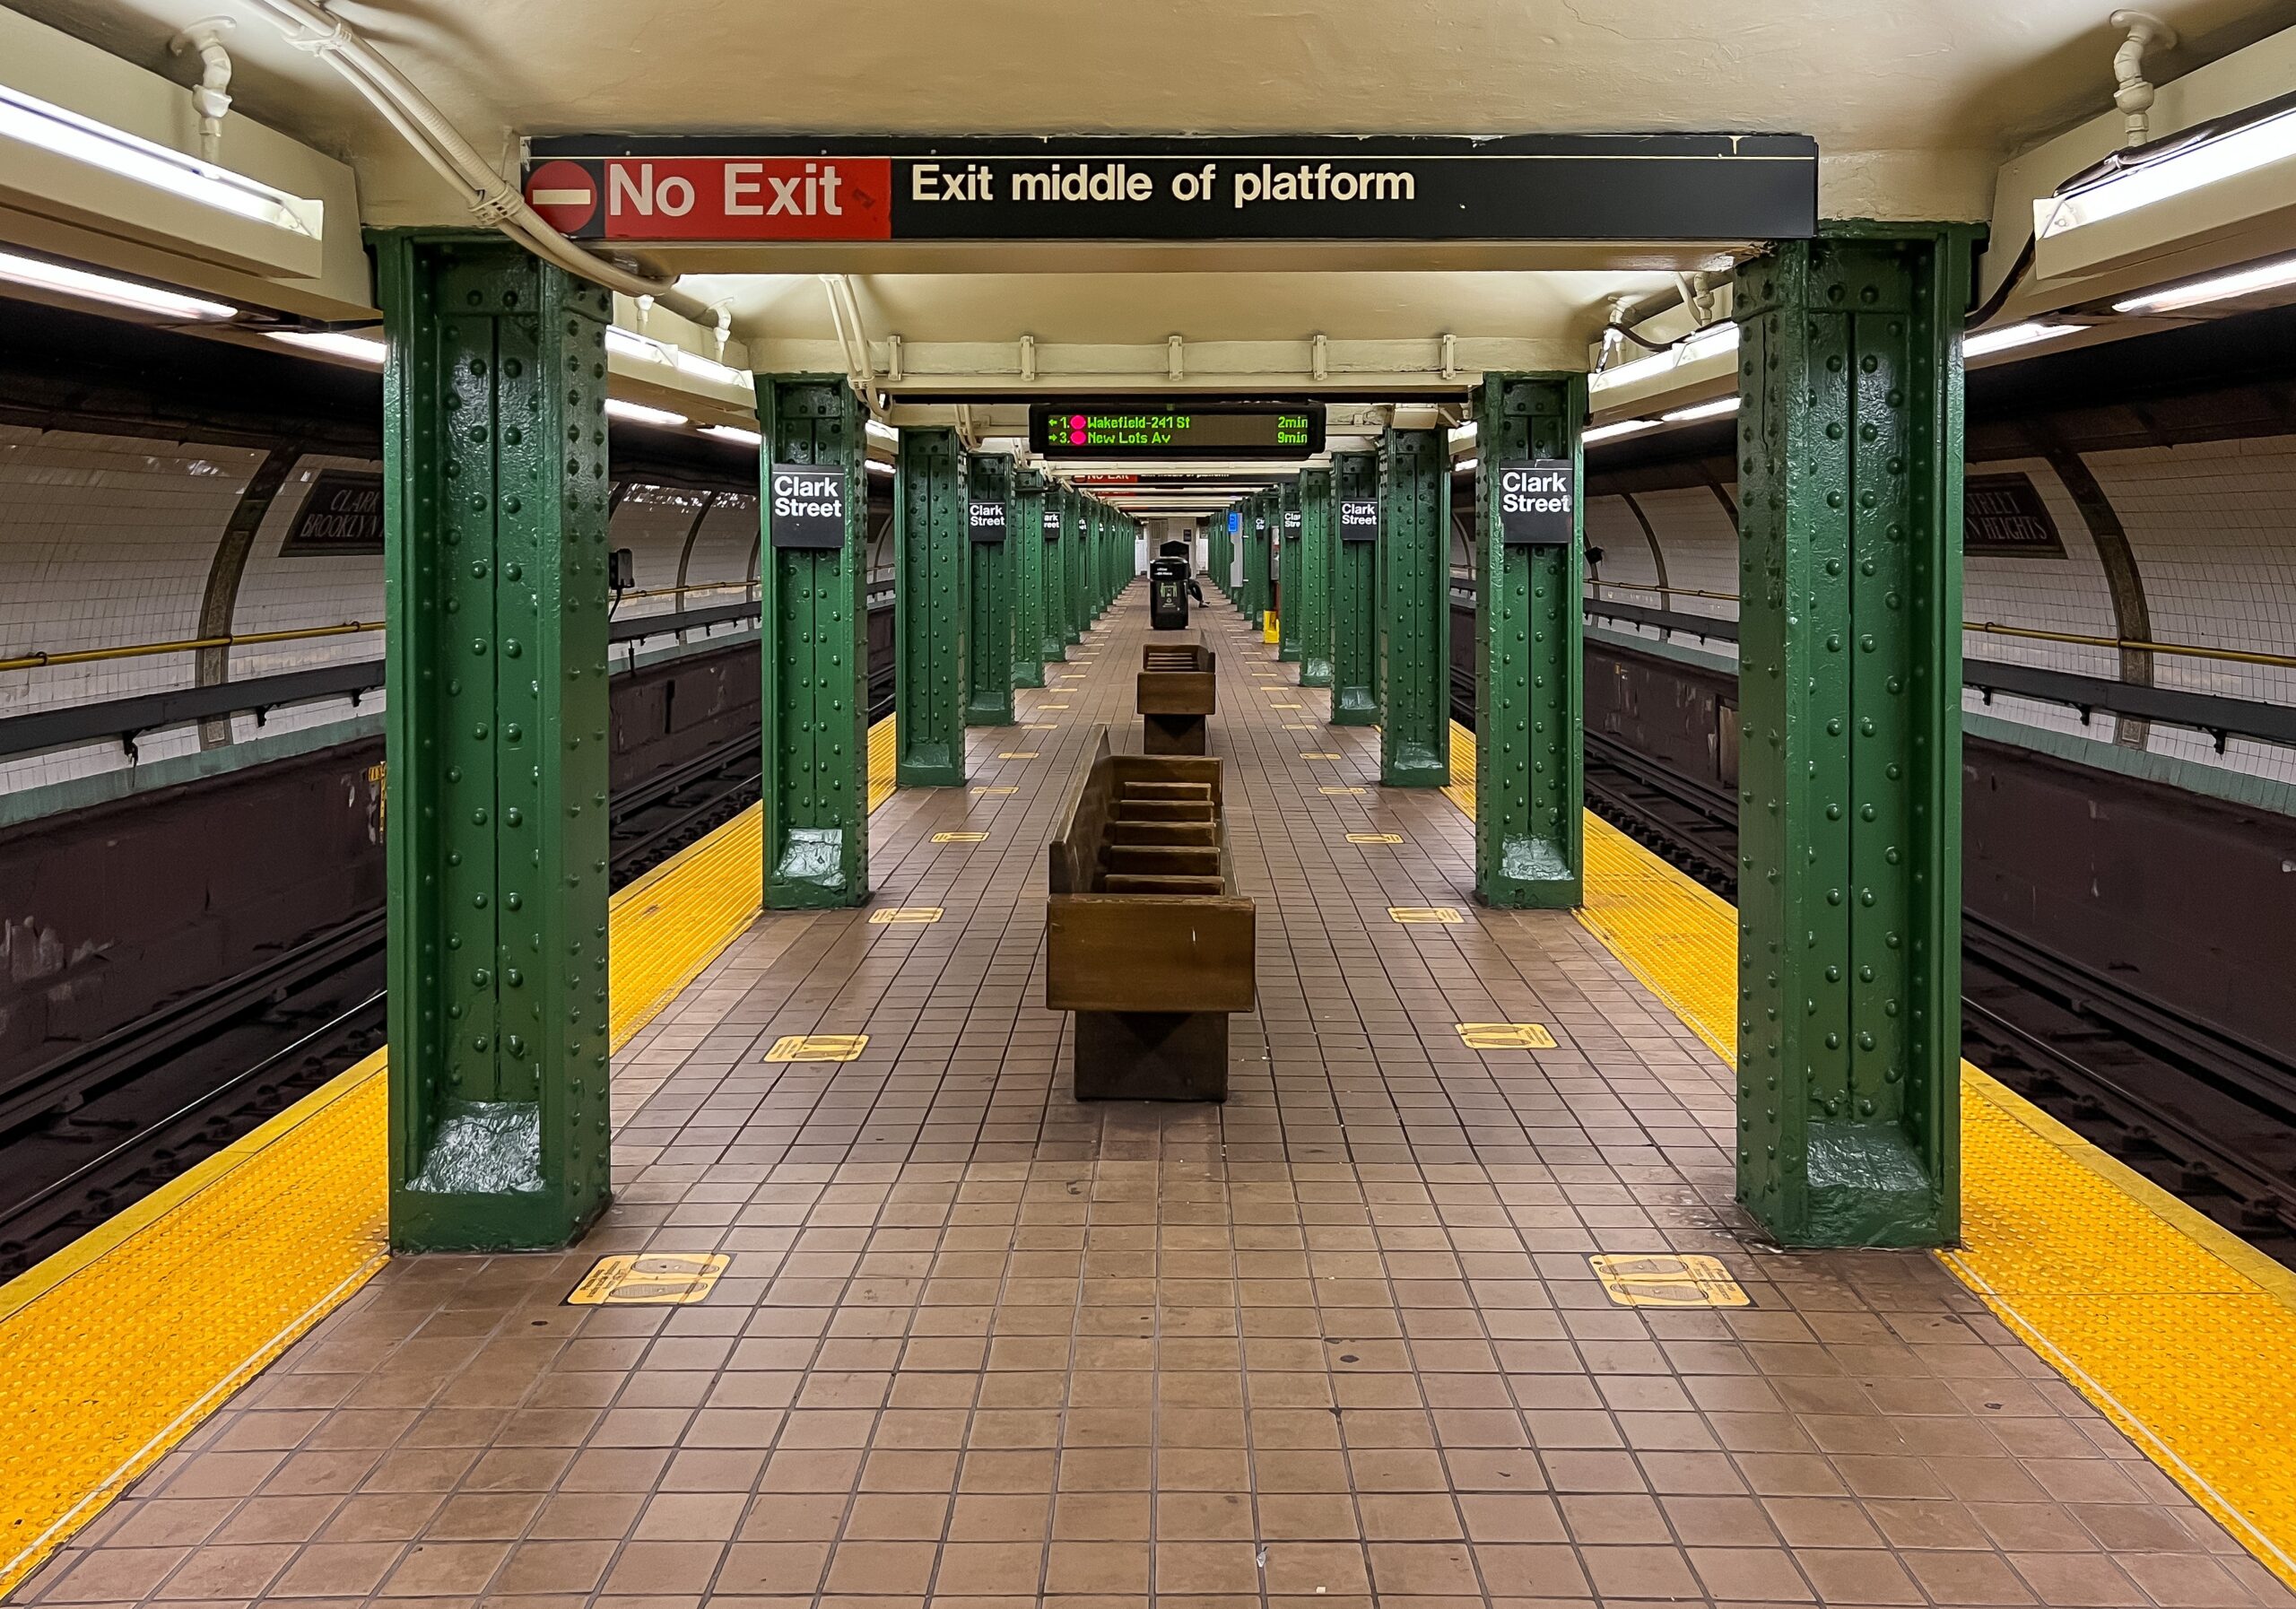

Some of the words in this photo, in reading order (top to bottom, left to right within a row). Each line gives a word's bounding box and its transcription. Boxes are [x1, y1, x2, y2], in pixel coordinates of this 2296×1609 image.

[609, 163, 695, 216] No
[725, 162, 842, 216] Exit
[912, 164, 993, 201] Exit
[1012, 164, 1152, 201] middle
[1172, 163, 1216, 202] of
[1235, 163, 1416, 208] platform
[1087, 416, 1173, 429] Wakefield-241
[1176, 416, 1191, 429] St
[1277, 415, 1309, 429] 2min
[1087, 431, 1116, 444] New
[1118, 431, 1148, 444] Lots
[1151, 431, 1171, 444] Av
[1277, 431, 1308, 444] 9min
[774, 475, 839, 497] Clark
[1502, 472, 1567, 492] Clark
[330, 488, 381, 512] CLARK
[775, 497, 842, 517] Street
[1341, 504, 1375, 515] Clark
[1502, 493, 1570, 512] Street
[970, 505, 1004, 516] Clark
[1341, 515, 1378, 526] Street
[300, 513, 378, 537] BROOKLYN
[970, 516, 1005, 526] Street
[1979, 516, 2048, 540] HEIGHTS
